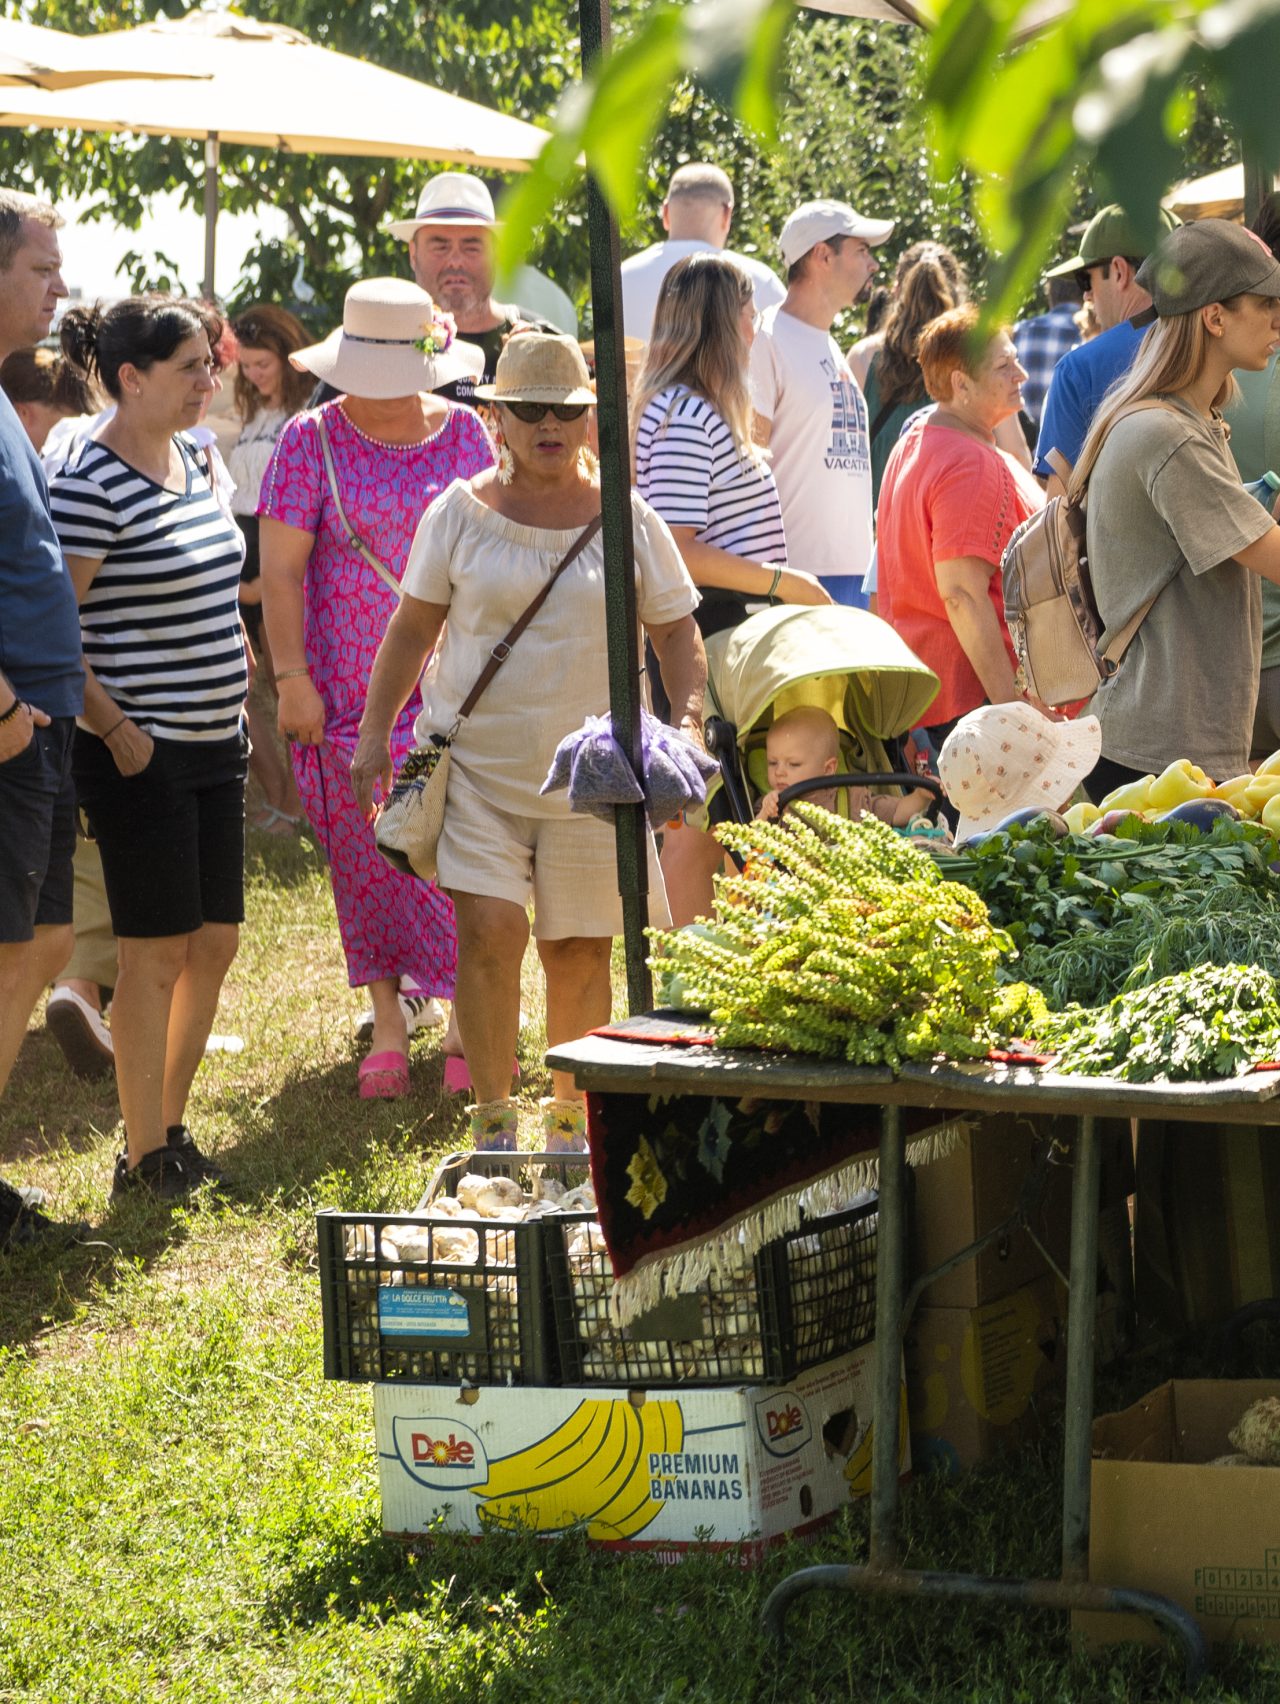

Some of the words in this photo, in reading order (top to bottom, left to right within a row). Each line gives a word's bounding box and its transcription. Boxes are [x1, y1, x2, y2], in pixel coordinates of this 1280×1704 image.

[456, 385, 475, 397] COM
[392, 1294, 400, 1302] LA
[402, 1294, 421, 1303] DOLCE
[422, 1294, 447, 1304] FRUTTA
[766, 1403, 802, 1436] Dole
[411, 1433, 475, 1466] Dole
[649, 1453, 739, 1474] PREMIUM
[651, 1479, 743, 1500] BANANAS
[1272, 1555, 1278, 1567] 1
[1208, 1572, 1216, 1584] 0
[1225, 1573, 1231, 1585] 1
[1240, 1574, 1248, 1585] 2
[1256, 1575, 1263, 1586] 3
[1271, 1575, 1279, 1586] 4
